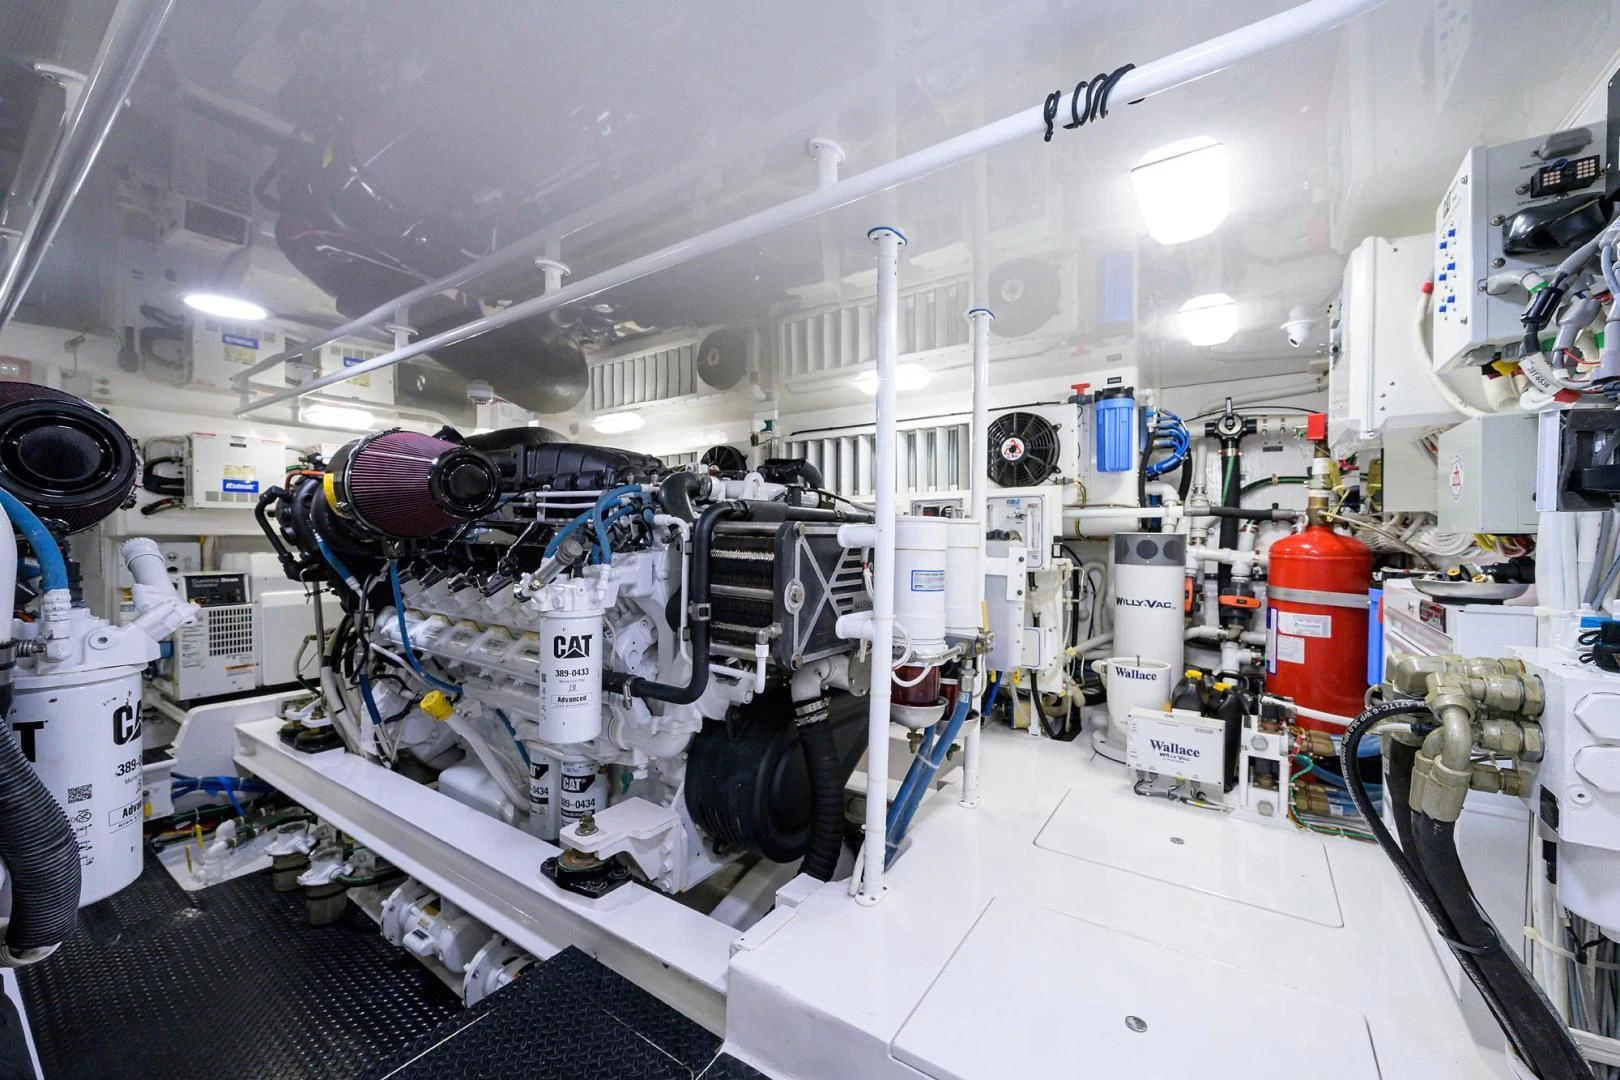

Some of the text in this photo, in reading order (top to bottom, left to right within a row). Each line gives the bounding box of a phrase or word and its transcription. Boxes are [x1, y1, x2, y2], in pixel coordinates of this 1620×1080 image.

[553, 634, 593, 659] CAT
[555, 667, 589, 677] 389-0433
[1115, 666, 1157, 681] Wallace
[557, 694, 587, 703] Advanced
[1150, 739, 1201, 758] Wallace
[563, 777, 582, 791] CAT
